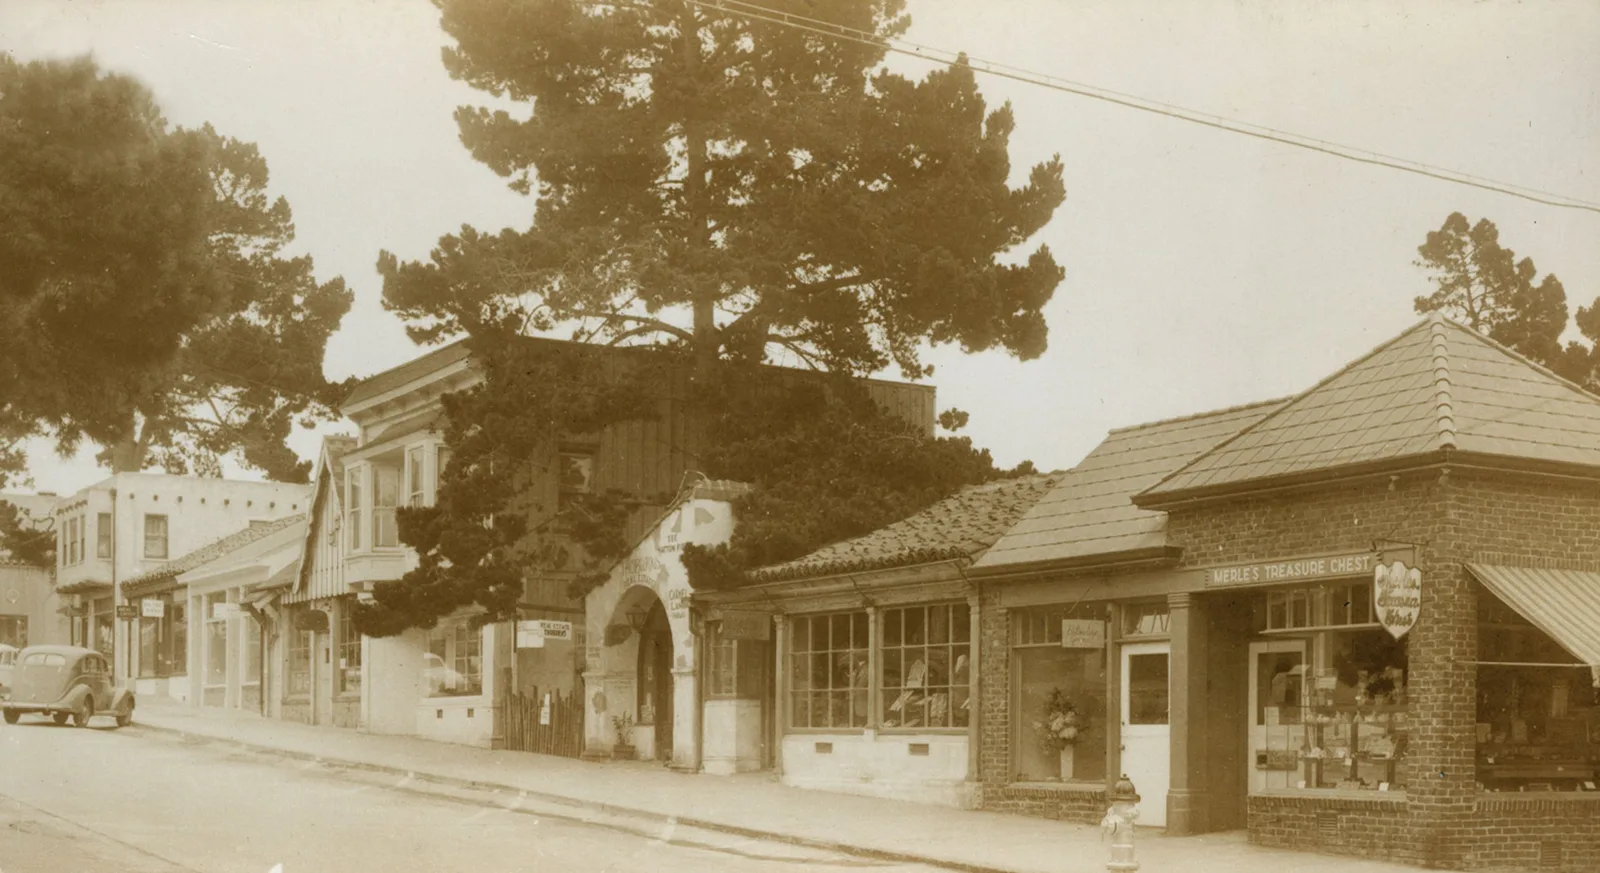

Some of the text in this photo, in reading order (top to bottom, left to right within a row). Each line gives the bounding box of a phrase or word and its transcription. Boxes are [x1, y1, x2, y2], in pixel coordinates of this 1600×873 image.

[1213, 556, 1371, 584] MERLE'S TREASURE CHEST
